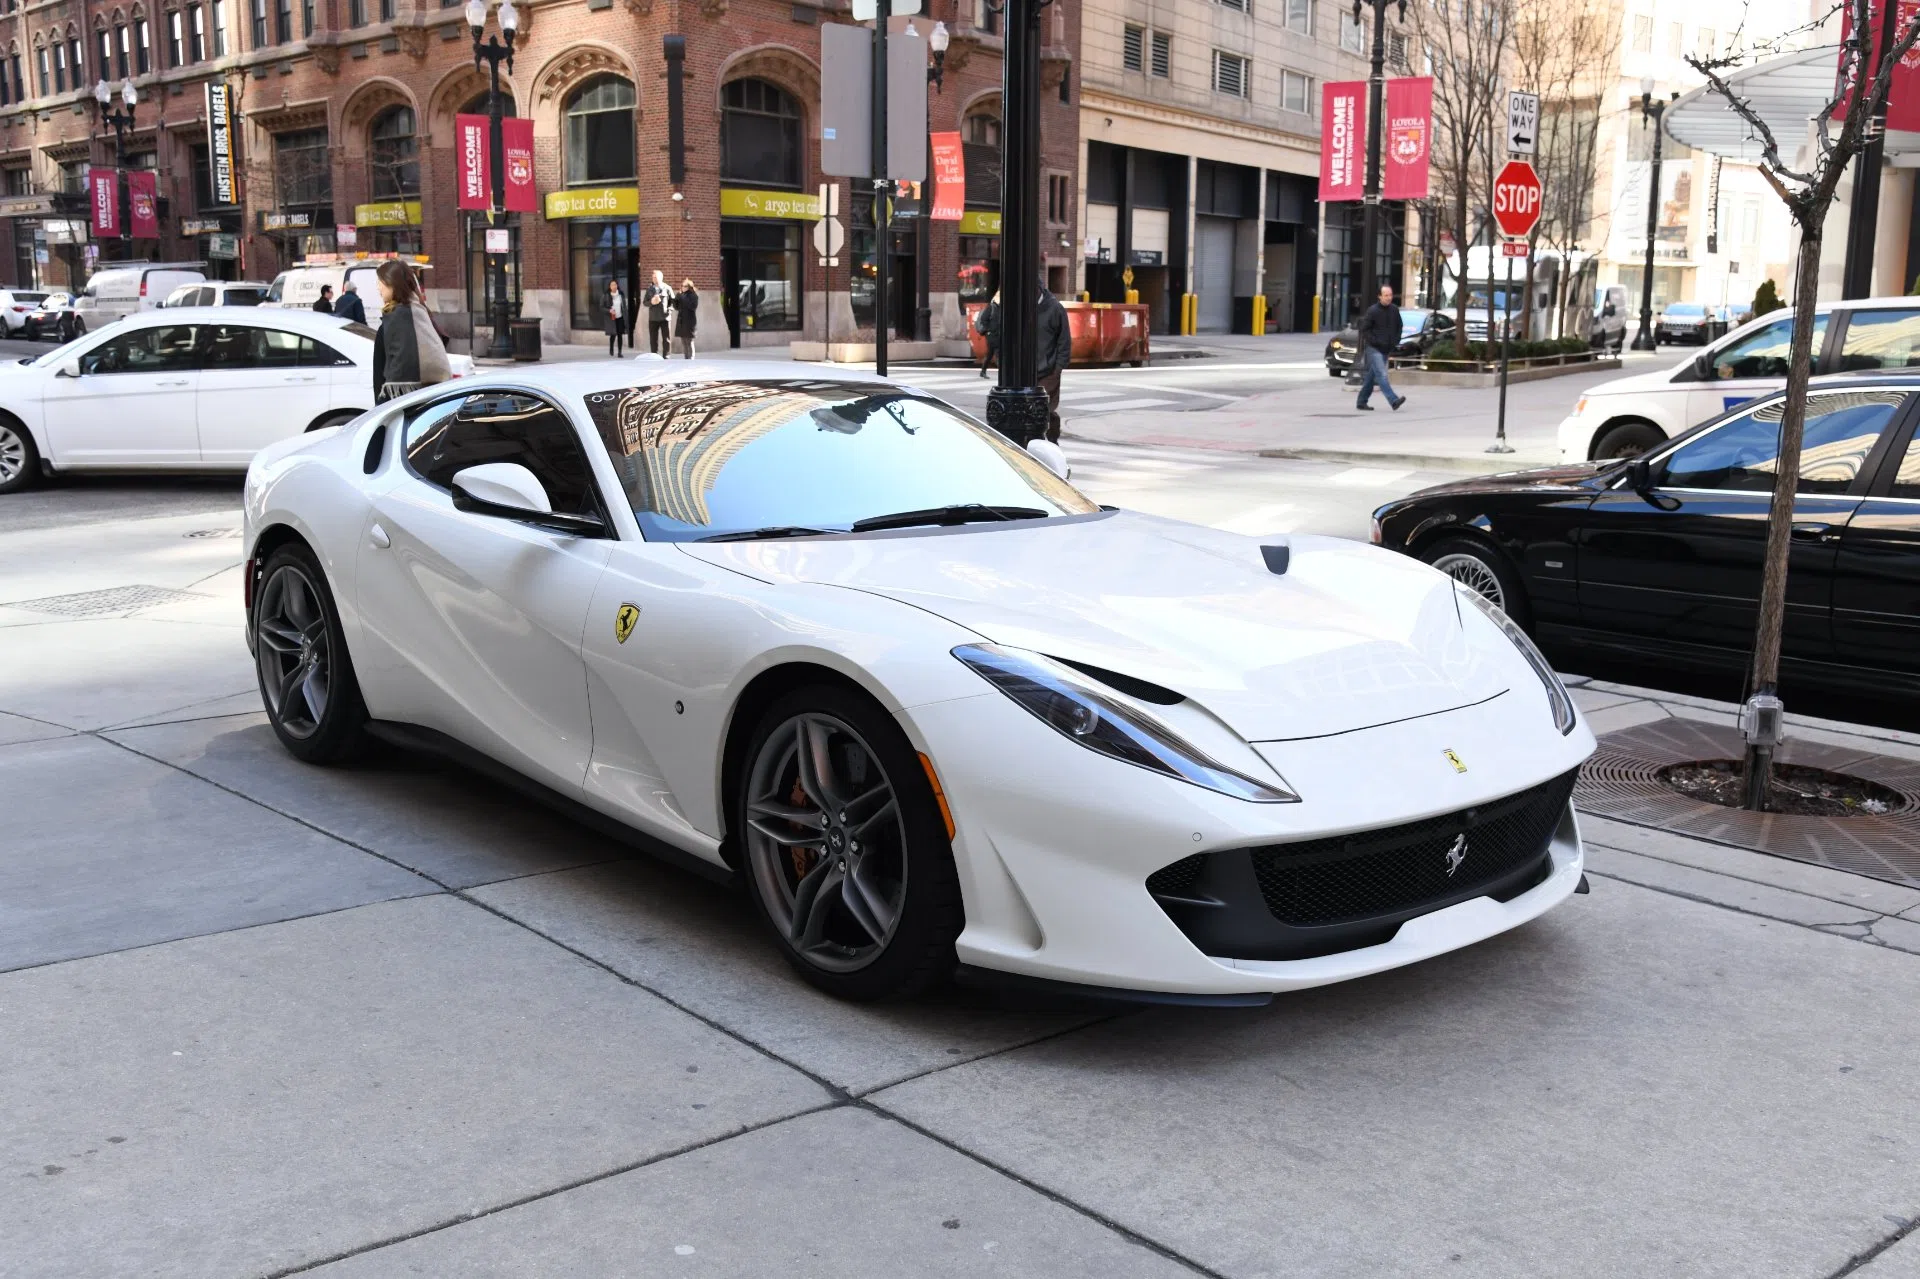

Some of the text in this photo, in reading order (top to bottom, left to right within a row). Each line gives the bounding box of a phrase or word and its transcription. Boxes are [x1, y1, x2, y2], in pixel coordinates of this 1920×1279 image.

[212, 85, 227, 125] BAGELS
[1512, 97, 1534, 114] ONE
[1392, 118, 1425, 127] LOYOLA
[1511, 114, 1535, 131] WAY
[1331, 96, 1347, 187] WELCOME
[1345, 96, 1355, 187] WATER TOWER CAMPUS
[465, 126, 478, 198] WELCOME
[216, 155, 231, 202] EINSTEIN
[96, 178, 108, 229] WELCOME
[588, 190, 617, 210] café
[764, 200, 791, 217] argo
[792, 200, 805, 214] tea
[1496, 183, 1539, 214] STOP
[1504, 244, 1513, 255] ALL
